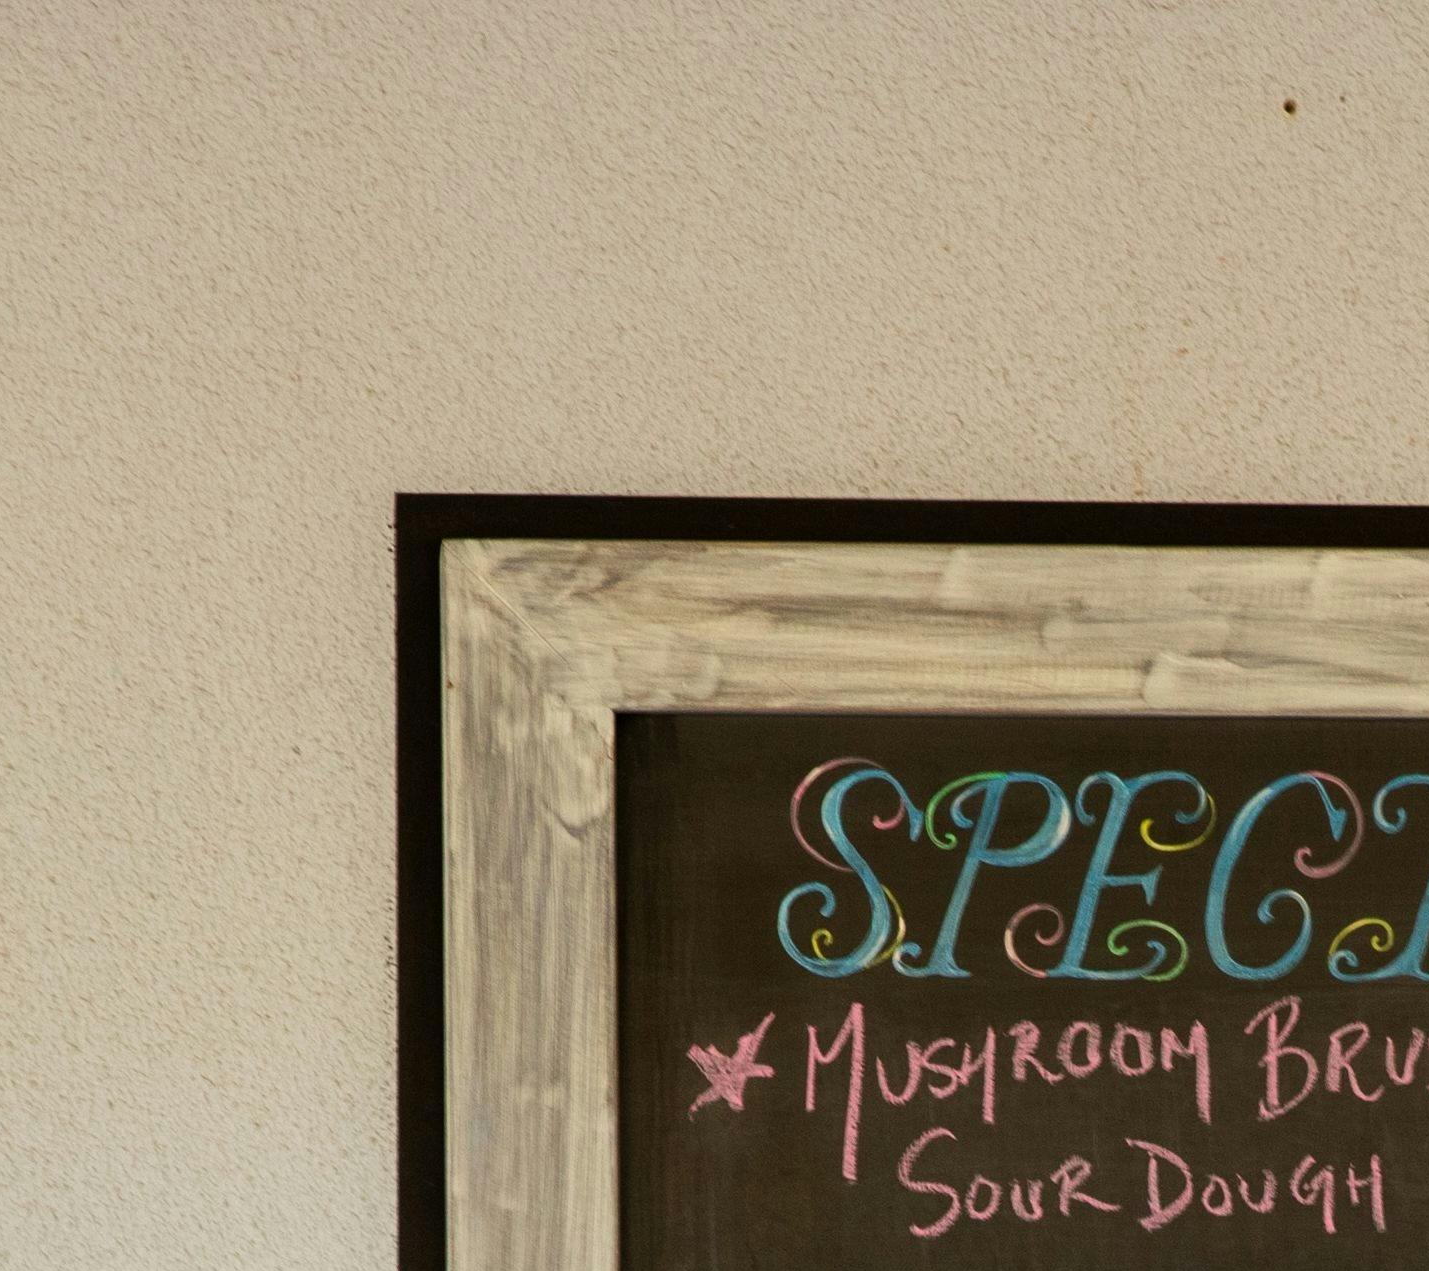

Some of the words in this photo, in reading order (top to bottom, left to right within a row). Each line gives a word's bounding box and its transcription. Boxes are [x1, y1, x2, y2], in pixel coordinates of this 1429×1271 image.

[803, 1001, 1213, 1184] MUSHROOM
[897, 1127, 1122, 1239] SOUR
[1124, 1137, 1387, 1236] DOUGH
